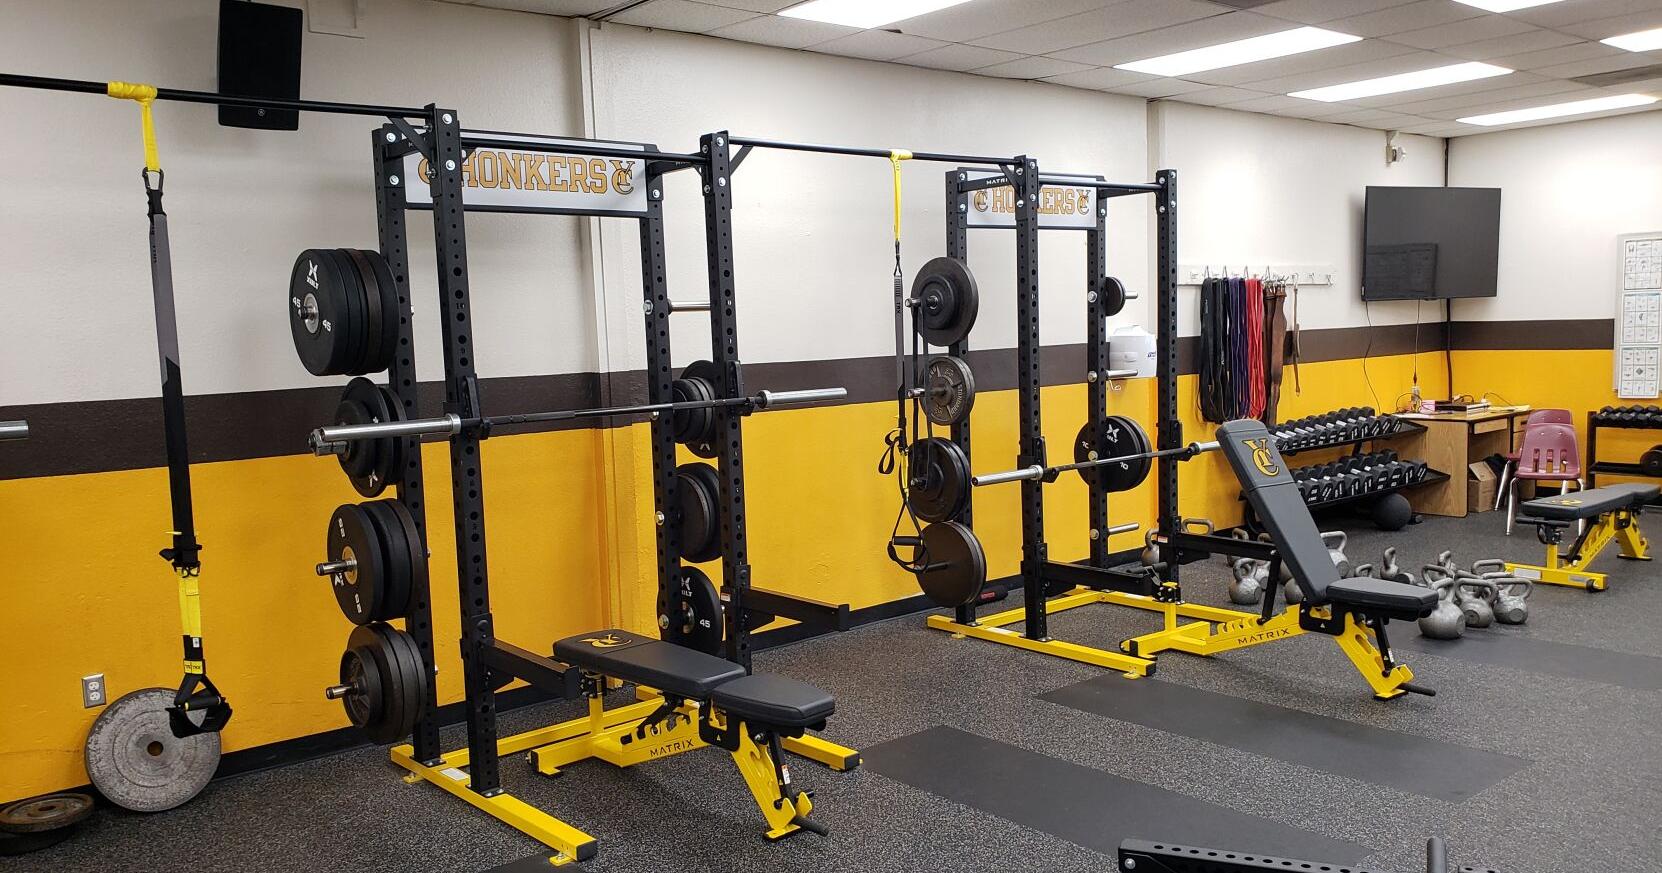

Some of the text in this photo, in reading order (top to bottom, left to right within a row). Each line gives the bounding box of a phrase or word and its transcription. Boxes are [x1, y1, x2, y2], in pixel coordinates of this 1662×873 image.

[461, 150, 608, 194] HONKERS
[986, 177, 1008, 186] MATRI
[991, 185, 1075, 215] HOERS
[292, 296, 301, 308] 45
[322, 319, 332, 332] 45
[699, 618, 711, 628] 45
[1237, 627, 1290, 645] MATRIX
[649, 737, 695, 758] MATRIX
